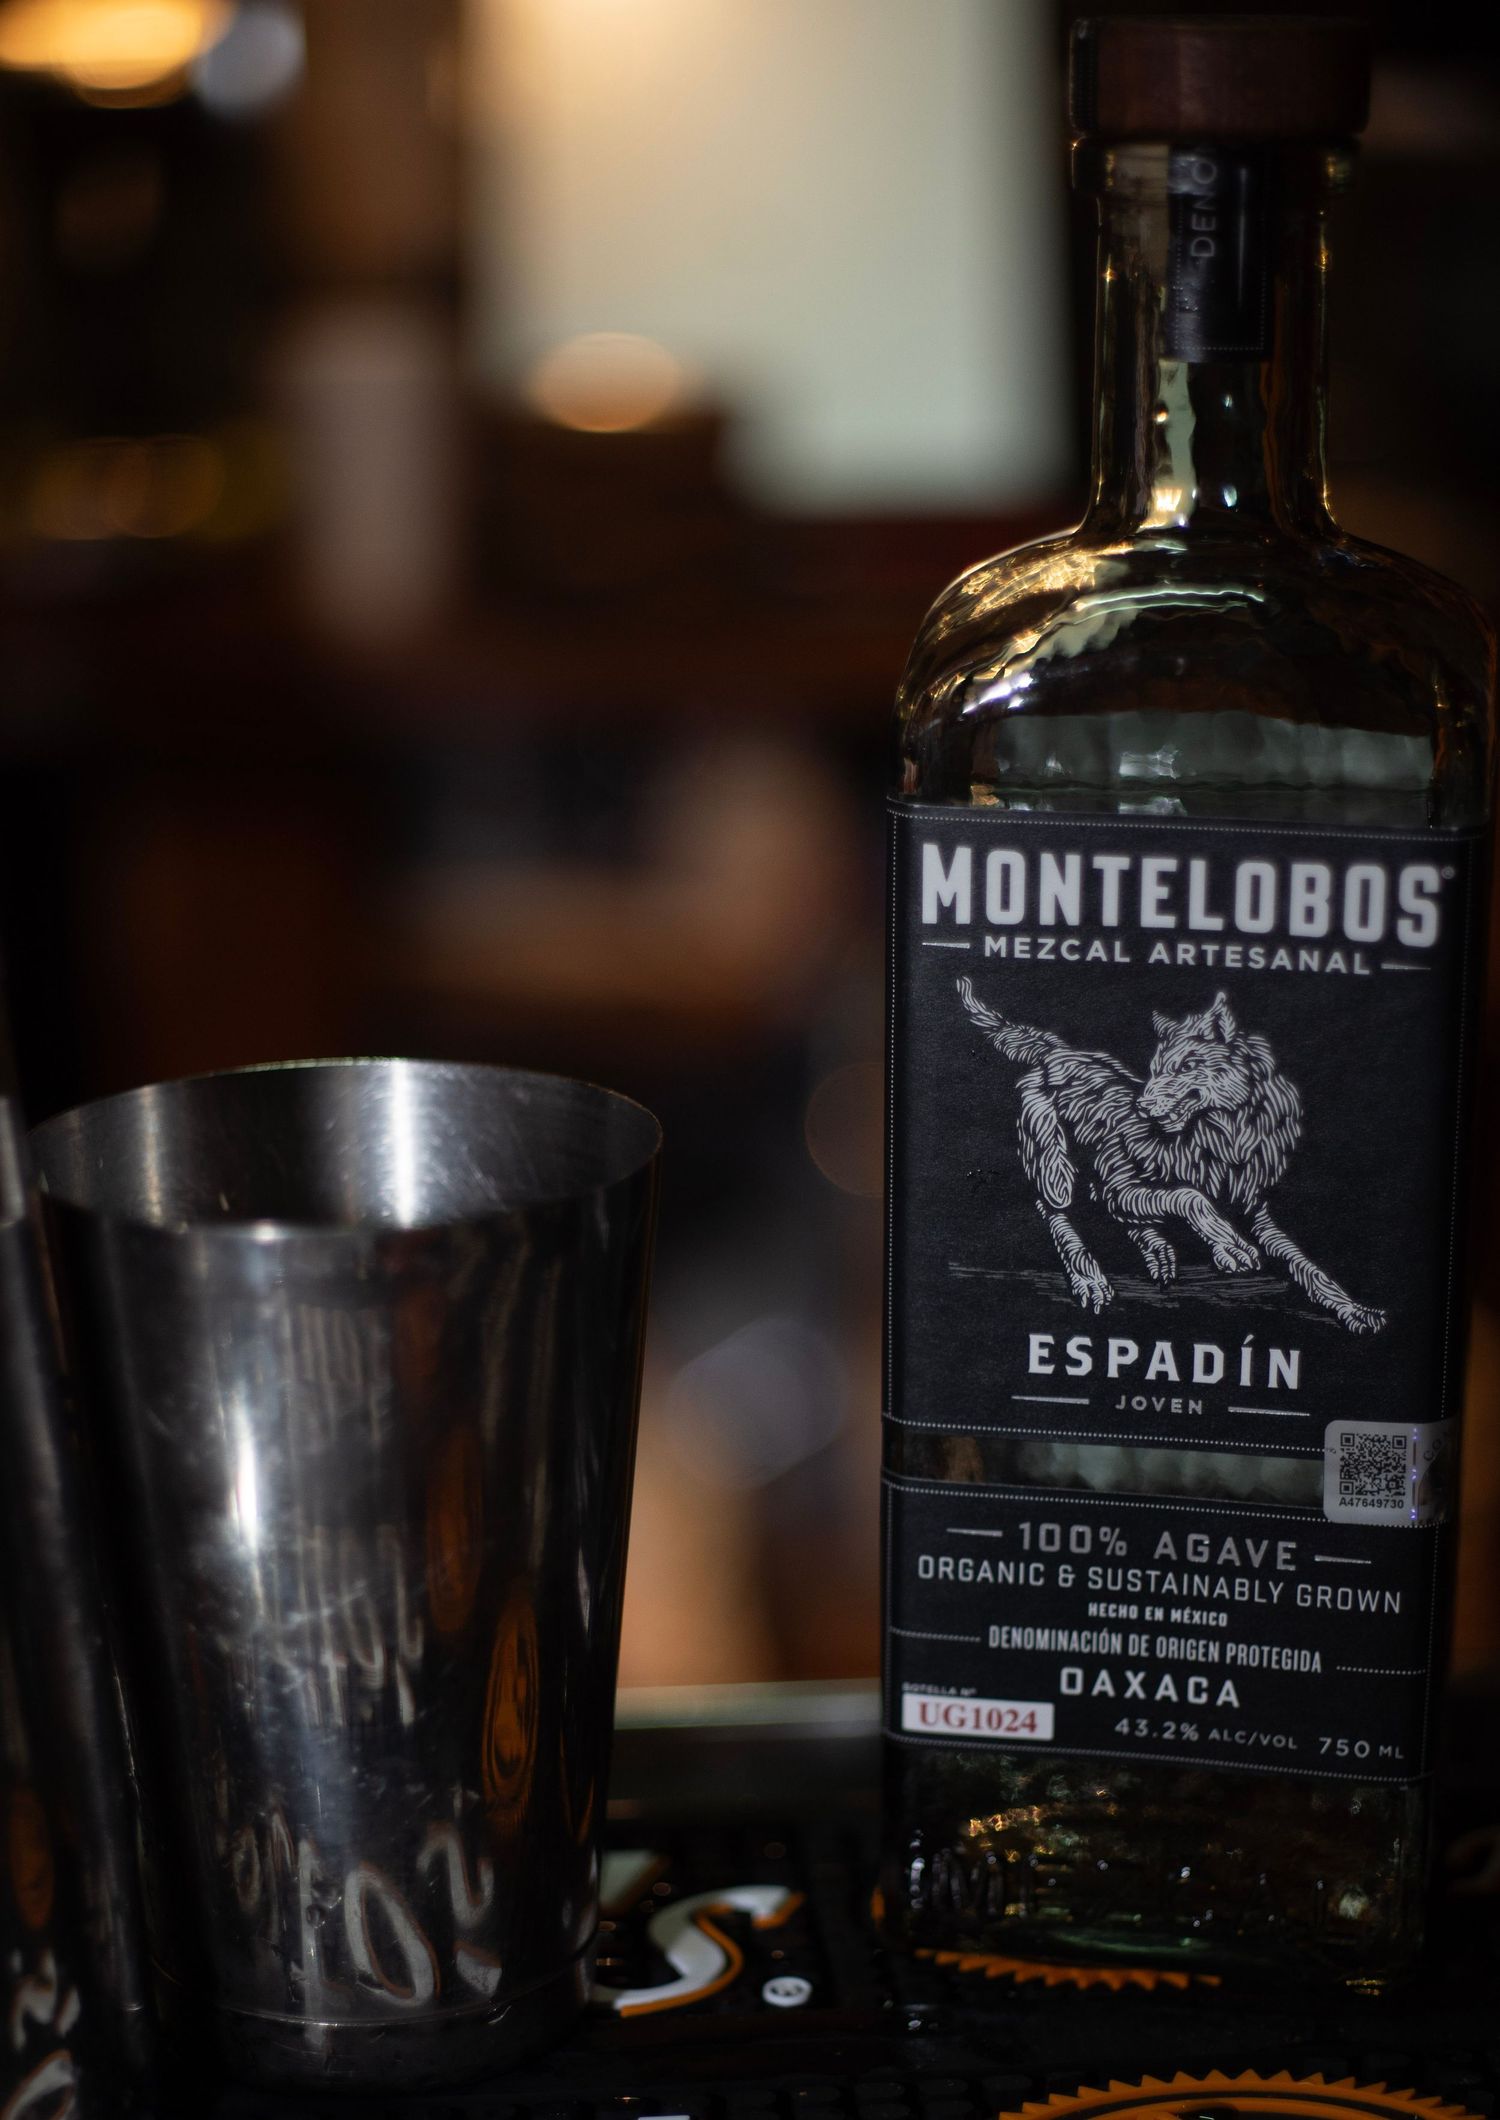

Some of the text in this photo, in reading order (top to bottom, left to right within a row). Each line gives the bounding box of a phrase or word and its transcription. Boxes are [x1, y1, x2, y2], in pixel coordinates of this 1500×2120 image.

[983, 935, 1371, 976] MEZCAL ARTESANAL
[1027, 1332, 1301, 1390] ESPADÍN
[1114, 1394, 1203, 1415] JOVEN
[1338, 1497, 1405, 1509] A47649730
[1017, 1521, 1297, 1572] 100% AGAVE
[917, 1554, 1402, 1615] ORGANIC & SUSTAINABLY GROWN
[1087, 1601, 1229, 1628] HECHO EN MÉXICO
[988, 1624, 1323, 1675] DENOMINACIÓN DE ORIGEN PROTEGIDA
[1059, 1666, 1241, 1709] OAXACA
[918, 1701, 1038, 1734] UG1024
[1113, 1717, 1405, 1760] 43.2% ALC/VOL 750 ML
